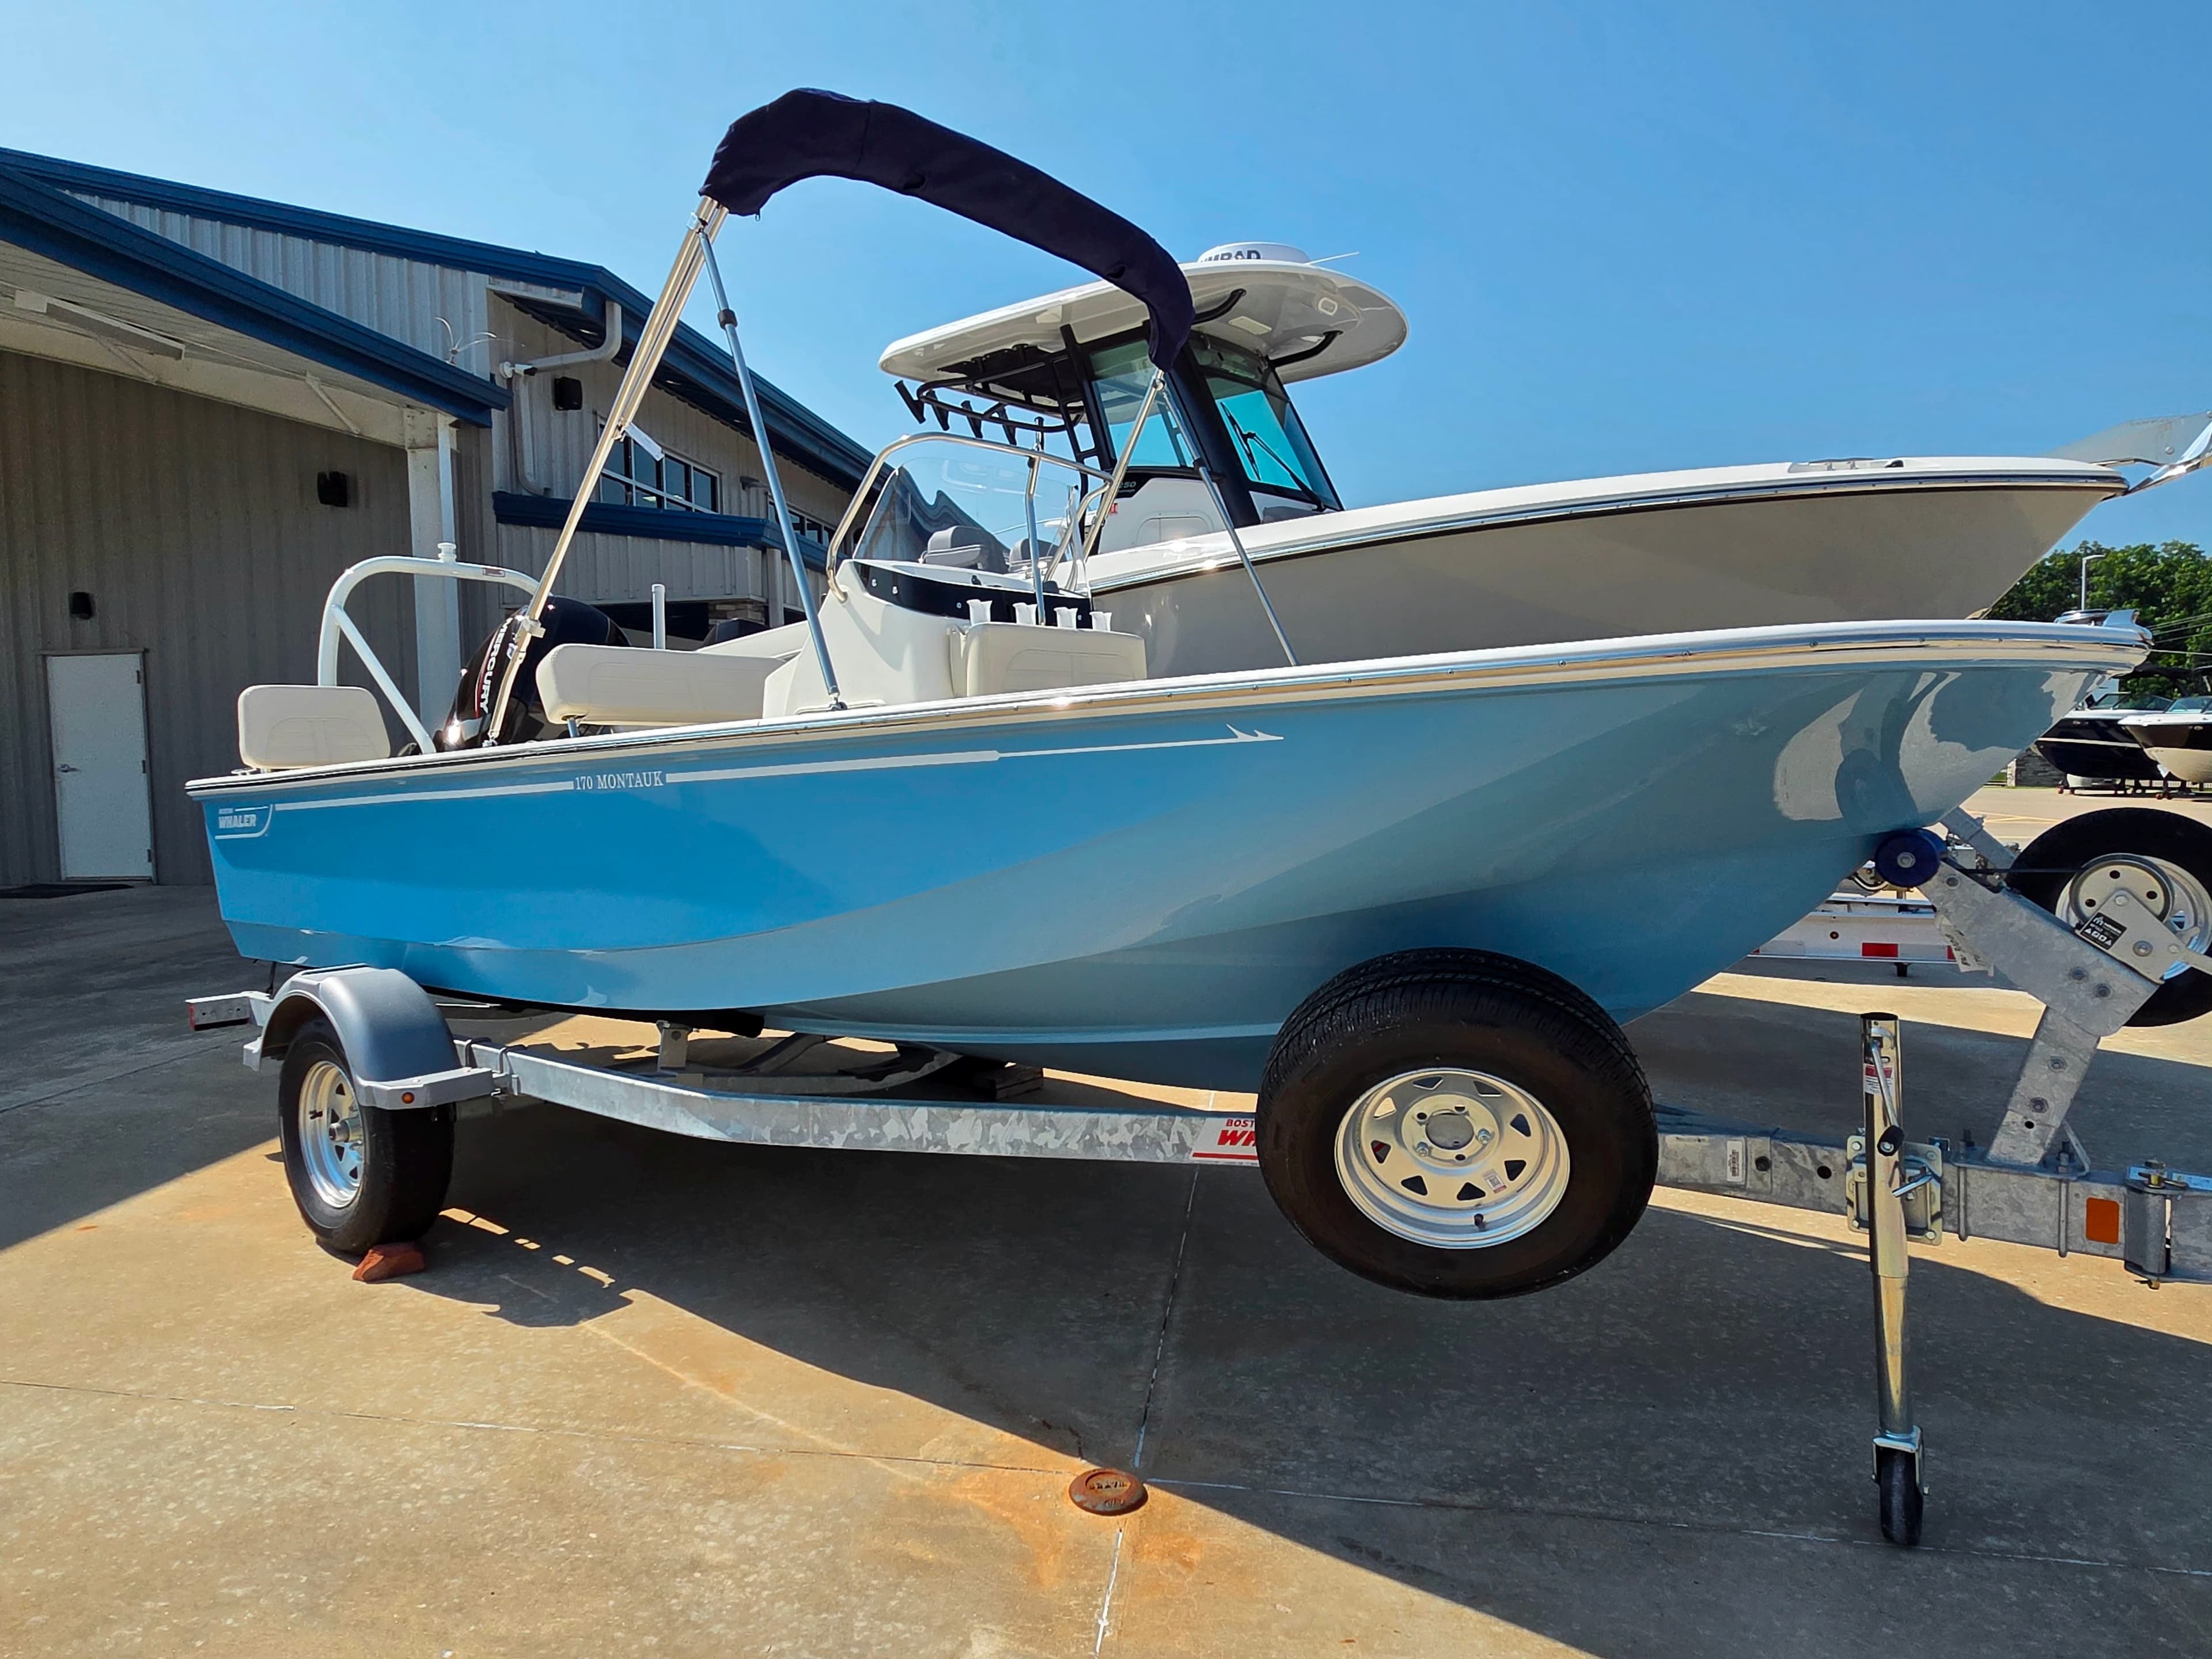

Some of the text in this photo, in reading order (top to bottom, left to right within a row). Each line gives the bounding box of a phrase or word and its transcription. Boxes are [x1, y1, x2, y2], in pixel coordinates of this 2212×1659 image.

[480, 618, 513, 714] MERCURY
[575, 771, 664, 790] 170 MONTAUK
[218, 814, 256, 828] WHALER
[1226, 1119, 1255, 1127] BOST
